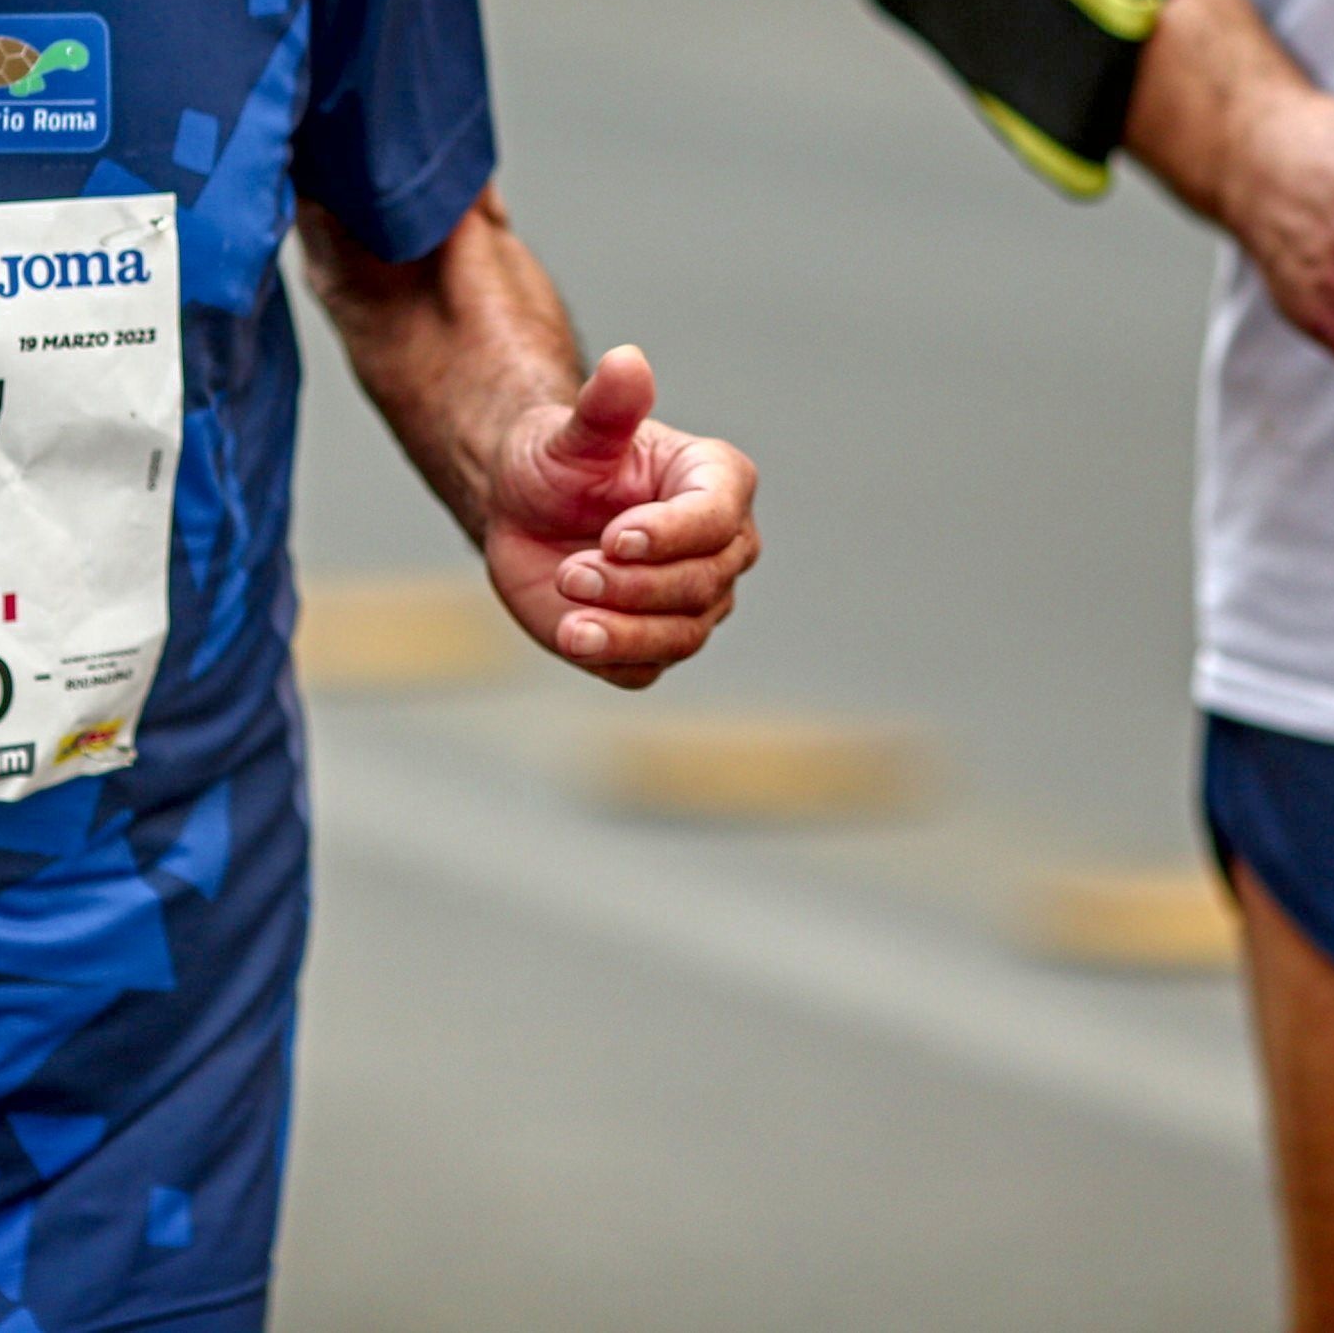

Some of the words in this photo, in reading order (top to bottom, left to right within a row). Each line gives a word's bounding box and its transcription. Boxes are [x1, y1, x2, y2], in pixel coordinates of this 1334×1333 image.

[33, 108, 96, 132] Roma
[18, 336, 37, 353] 19
[41, 330, 109, 351] MARZO
[114, 327, 156, 347] 2023
